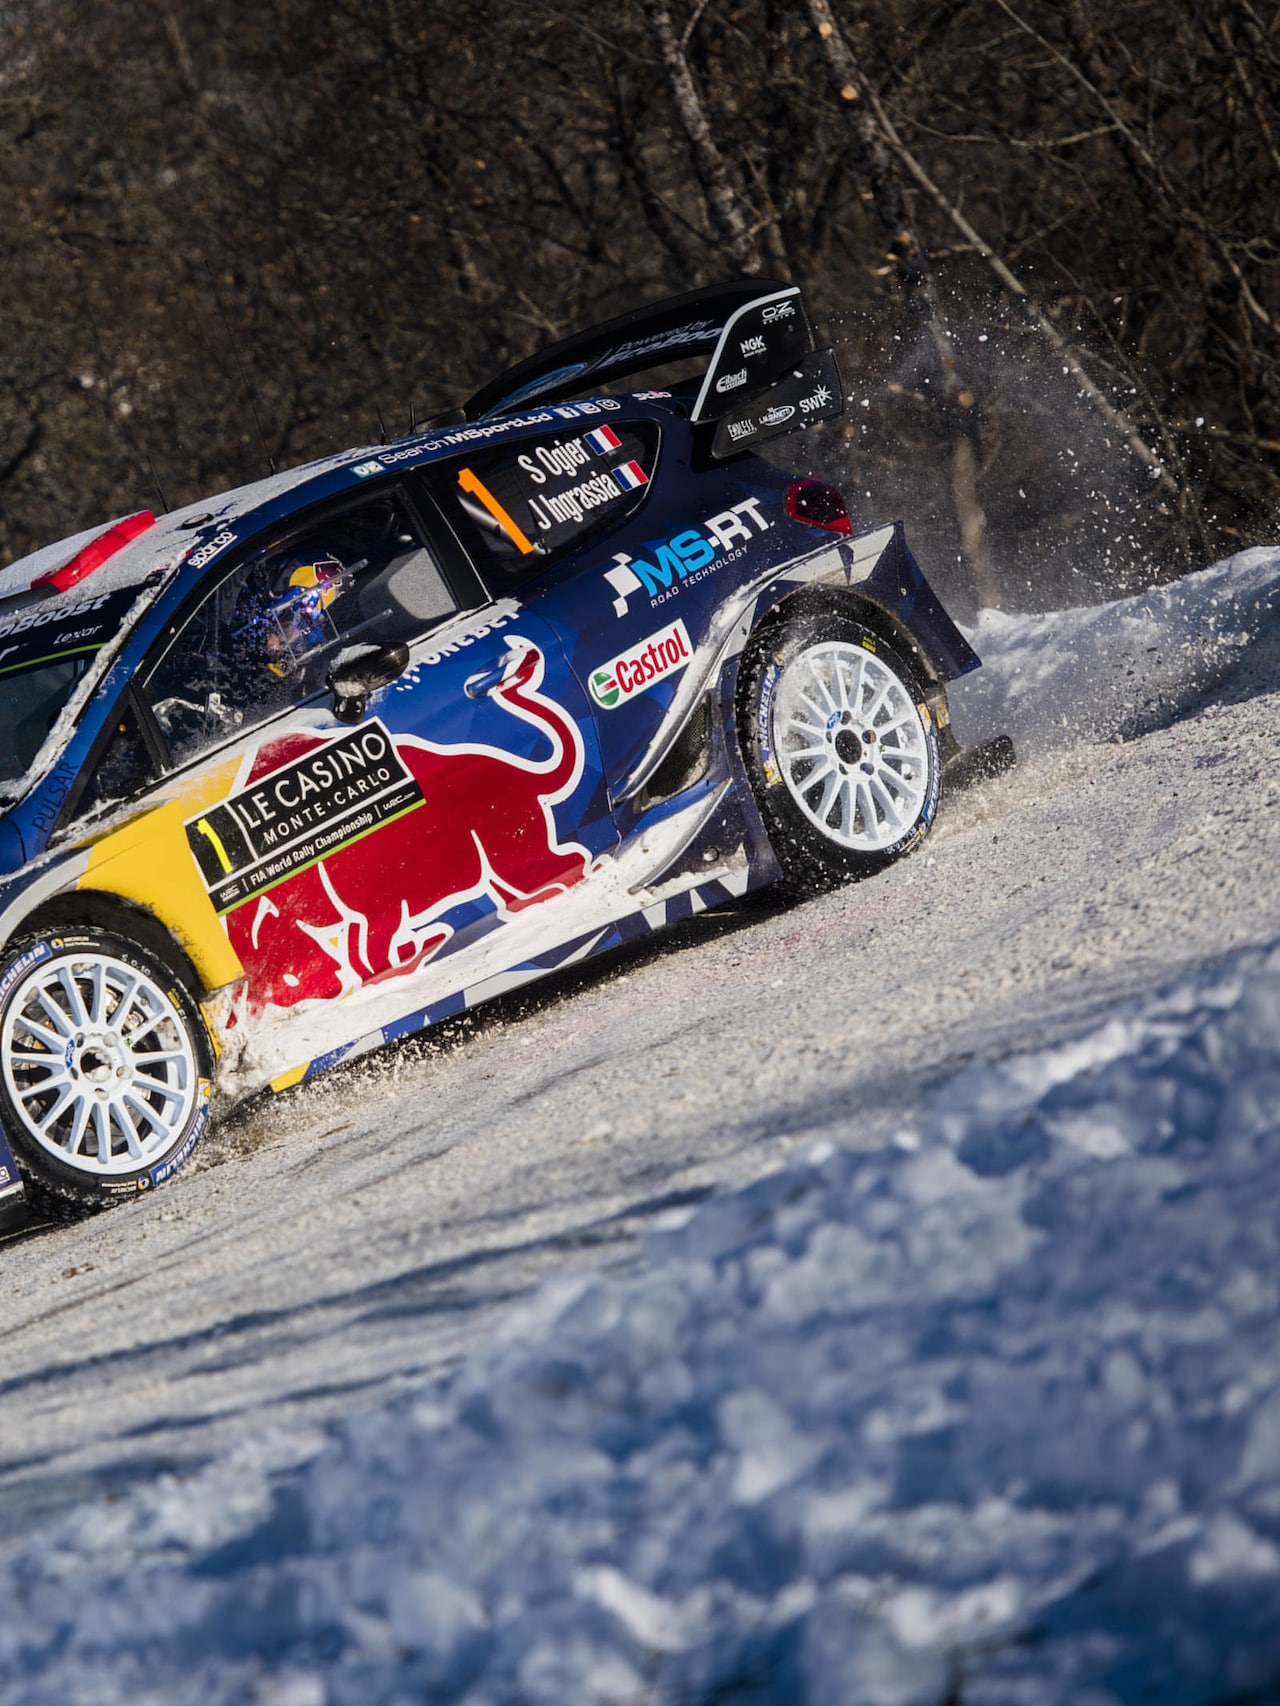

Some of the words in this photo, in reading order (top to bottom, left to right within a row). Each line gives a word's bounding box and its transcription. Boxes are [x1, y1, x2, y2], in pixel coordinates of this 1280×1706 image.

[740, 335, 766, 354] NGK
[799, 393, 828, 414] SWP
[517, 454, 547, 484] S
[535, 437, 591, 478] Ogier
[457, 467, 535, 556] 1
[528, 498, 553, 530] J
[546, 472, 622, 523] Ingrassia
[187, 531, 235, 568] sparco
[650, 586, 680, 609] ROAD
[682, 544, 749, 589] TECHNOLOGY
[615, 627, 689, 694] Castrol
[31, 761, 80, 833] PULSAR
[236, 791, 277, 830] LE
[274, 732, 387, 808] CASINO
[196, 817, 235, 875] 1
[250, 868, 268, 886] FIA
[266, 856, 293, 878] World
[293, 843, 315, 865] Rally
[314, 811, 374, 850] Championship
